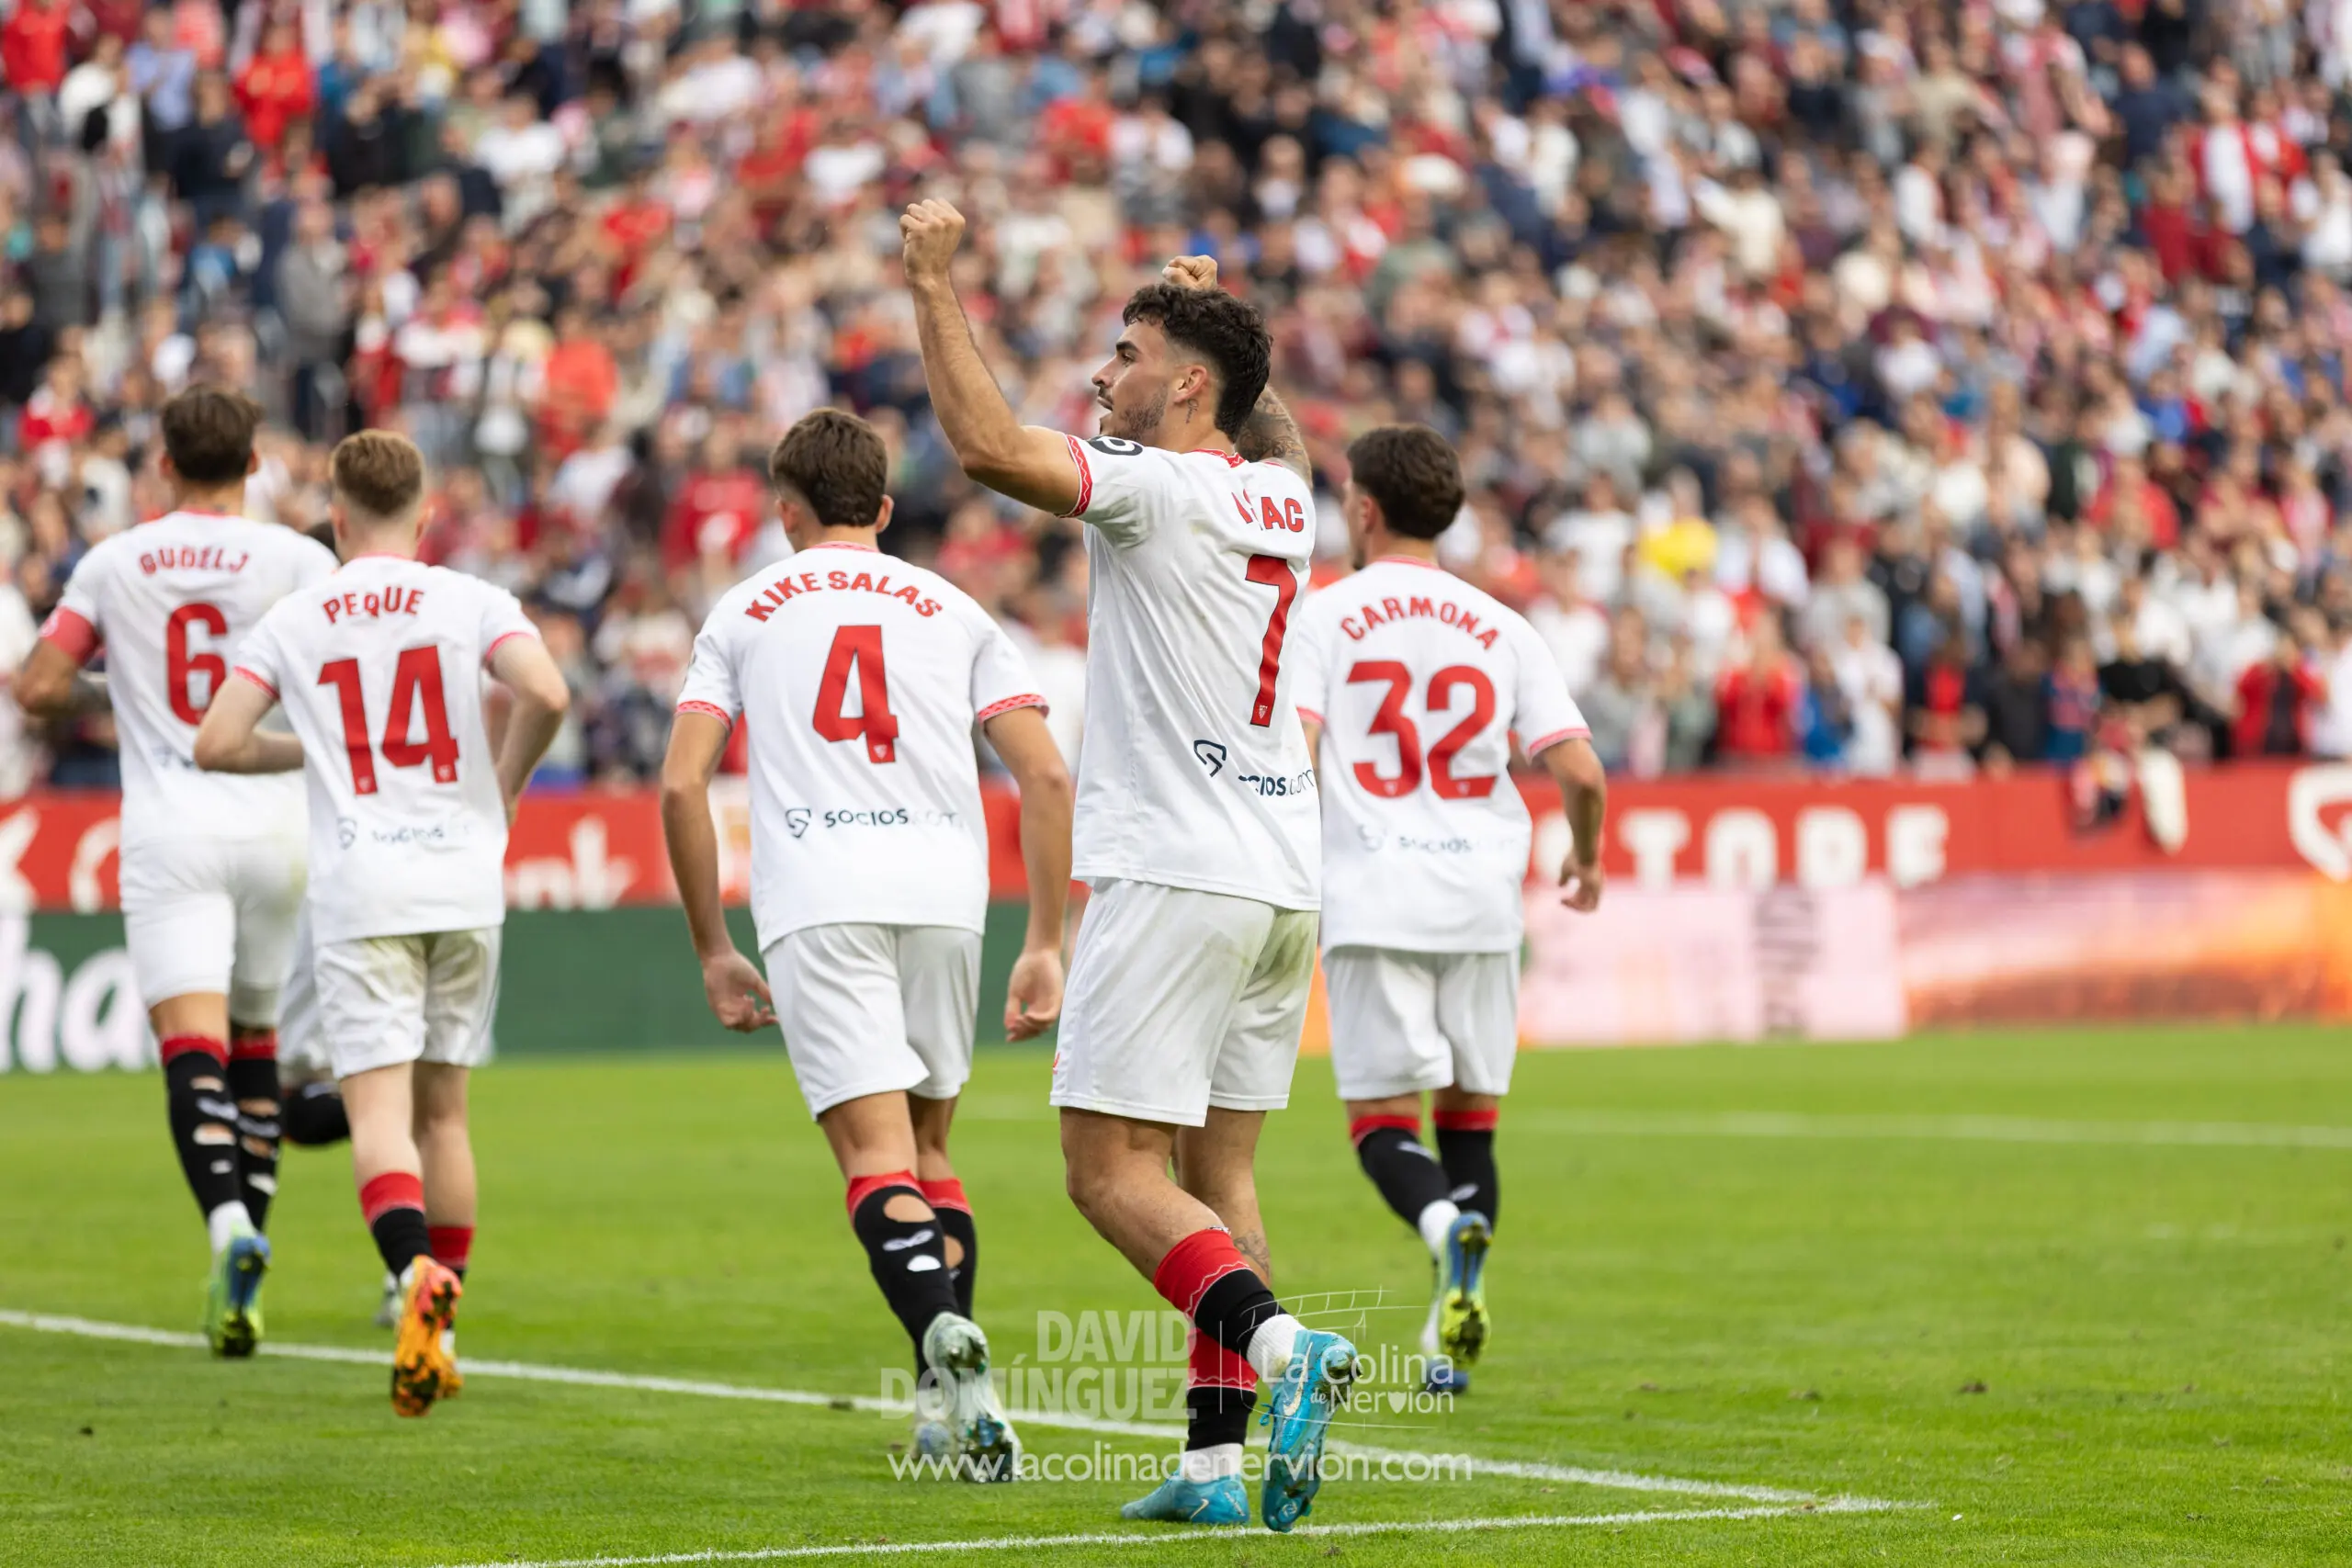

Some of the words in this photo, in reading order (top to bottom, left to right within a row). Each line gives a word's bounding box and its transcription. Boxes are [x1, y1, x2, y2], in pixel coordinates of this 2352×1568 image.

[139, 548, 250, 576] GUDELJ
[322, 586, 424, 625] PEQUE
[745, 572, 822, 623] KIKE
[828, 571, 943, 617] SALAS
[1340, 597, 1500, 650] CARMONA
[166, 603, 229, 726] 6
[813, 625, 899, 763] 4
[1245, 554, 1297, 728] 7
[317, 645, 459, 796] 14
[1346, 660, 1496, 800] 32
